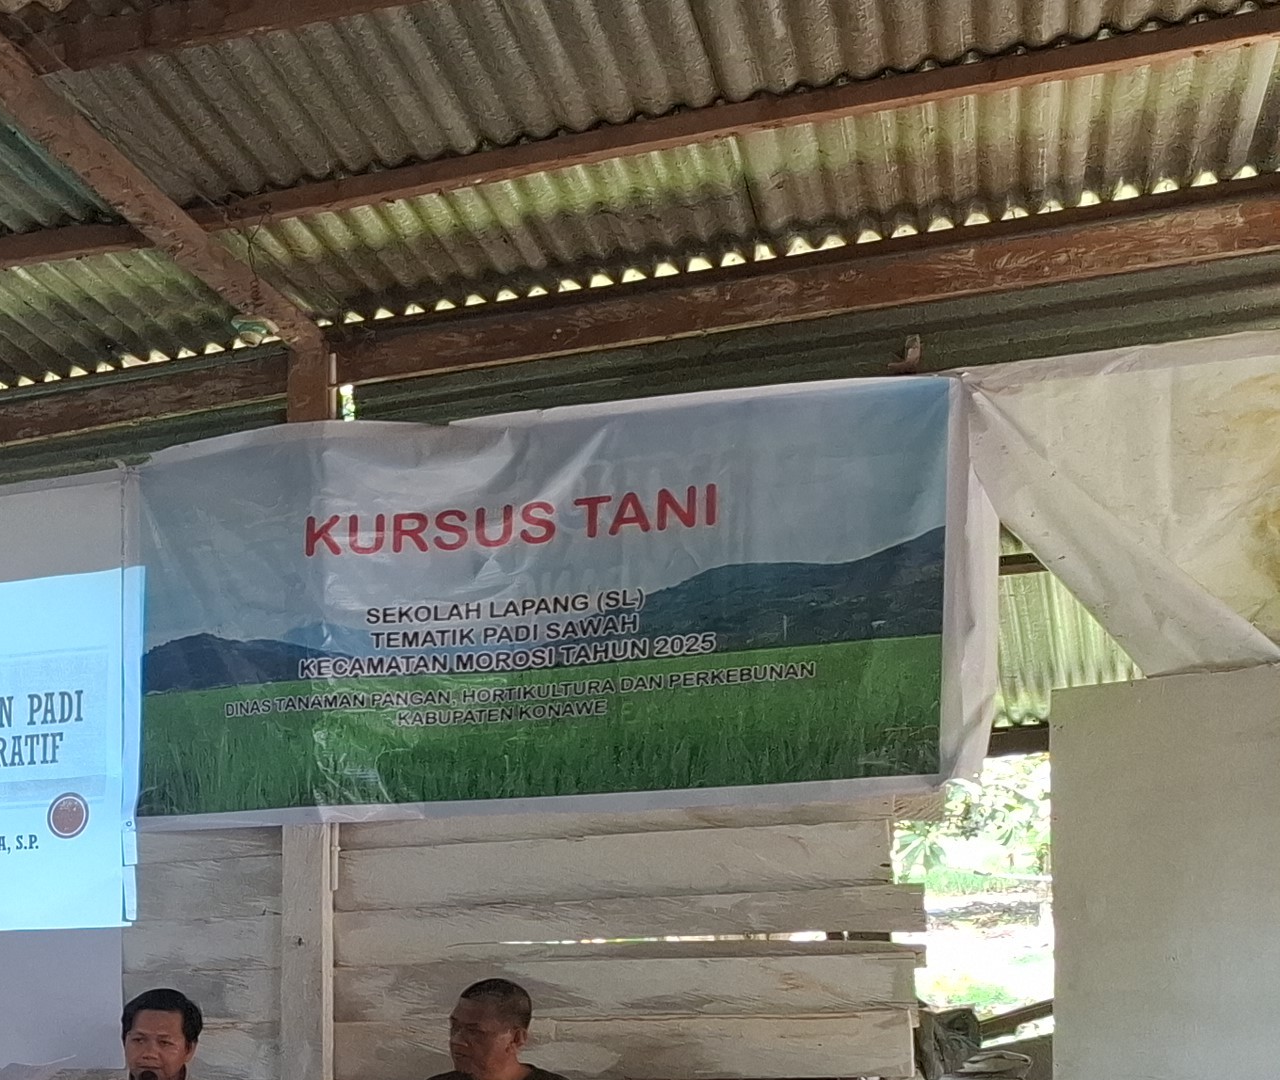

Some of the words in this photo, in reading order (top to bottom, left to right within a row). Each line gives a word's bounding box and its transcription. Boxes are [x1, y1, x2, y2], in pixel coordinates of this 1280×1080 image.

[304, 500, 557, 558] KURSUS
[573, 483, 719, 539] TANI
[366, 603, 482, 626] SEKOLAH
[489, 594, 589, 619] LAPANG
[597, 588, 646, 611] (SL)
[370, 628, 475, 650] TEMATIK
[483, 624, 539, 645] PADI
[545, 615, 639, 639] SAWAH
[298, 652, 448, 679] KECAMATAN
[454, 646, 554, 672] MOROSI
[561, 638, 648, 666] TAHUN
[654, 632, 717, 657] 2025
[26, 689, 84, 726] PADI
[225, 699, 271, 718] DINAS
[275, 694, 365, 713] TANAMAN
[370, 689, 457, 708] PANGAN,
[461, 679, 615, 705] HORTIKULTURA
[620, 675, 663, 693] DAN
[668, 662, 816, 689] PERKEBUNAN
[397, 706, 513, 726] KABUPATEN
[519, 700, 608, 722] KONAWE
[16, 834, 40, 850] S.P.
